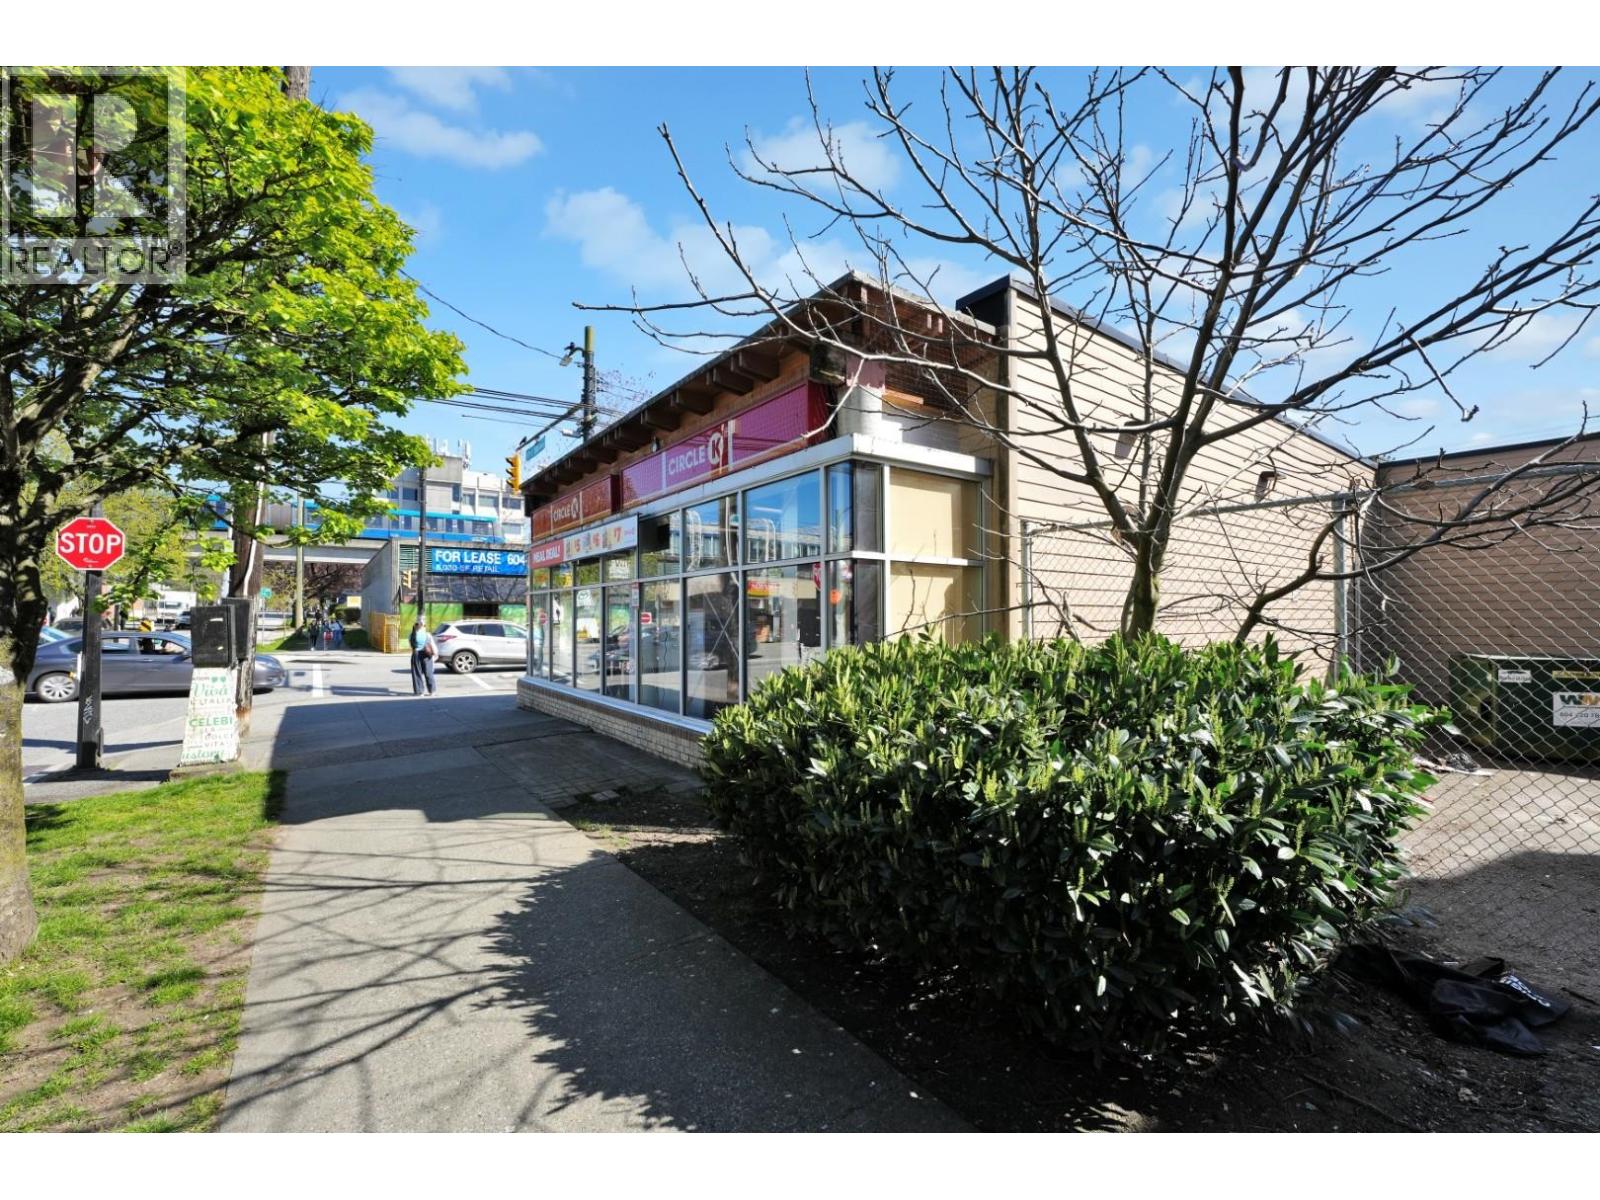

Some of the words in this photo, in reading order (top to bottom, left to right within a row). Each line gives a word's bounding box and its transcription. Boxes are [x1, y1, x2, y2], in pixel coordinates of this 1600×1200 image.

[668, 445, 706, 475] CIRCLE
[553, 506, 570, 521] CIRCLE
[60, 532, 121, 554] STOP
[435, 550, 461, 562] FOR
[463, 552, 502, 565] LEASE
